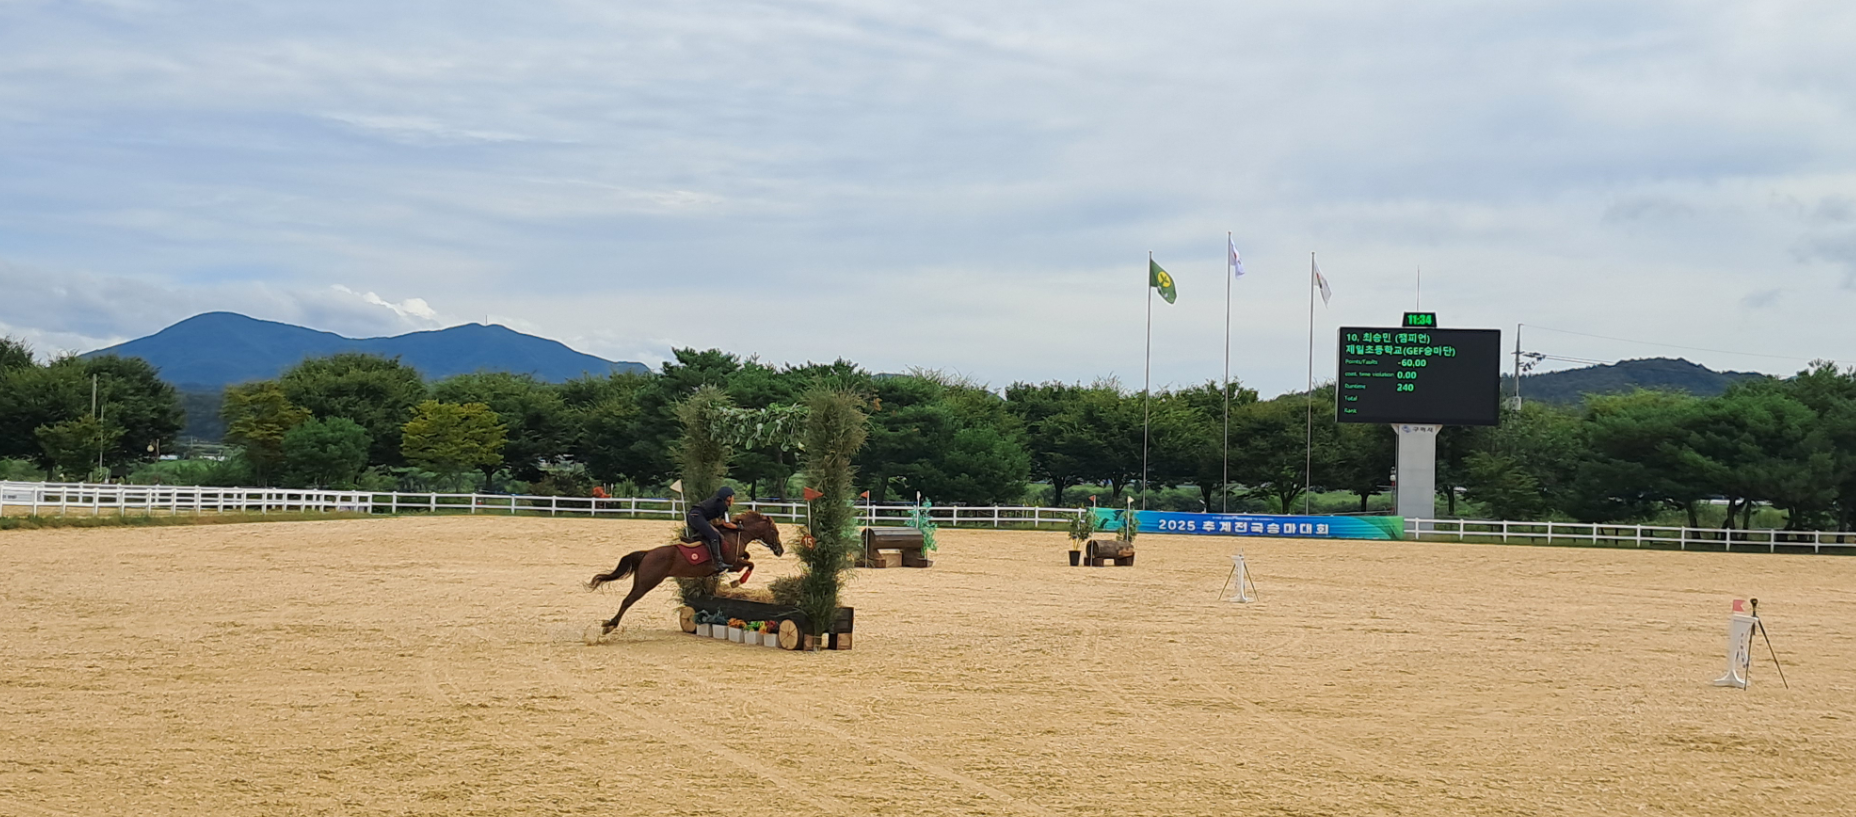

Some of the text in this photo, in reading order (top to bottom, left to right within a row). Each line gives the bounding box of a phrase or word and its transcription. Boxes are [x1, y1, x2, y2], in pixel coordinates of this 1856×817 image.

[1407, 314, 1432, 325] 11:34
[1363, 332, 1391, 343] 최승민
[1397, 359, 1427, 368] -60.00
[1397, 371, 1417, 379] 0.00
[1397, 383, 1414, 392] 240
[1158, 519, 1196, 531] 2025
[803, 537, 813, 548] 15
